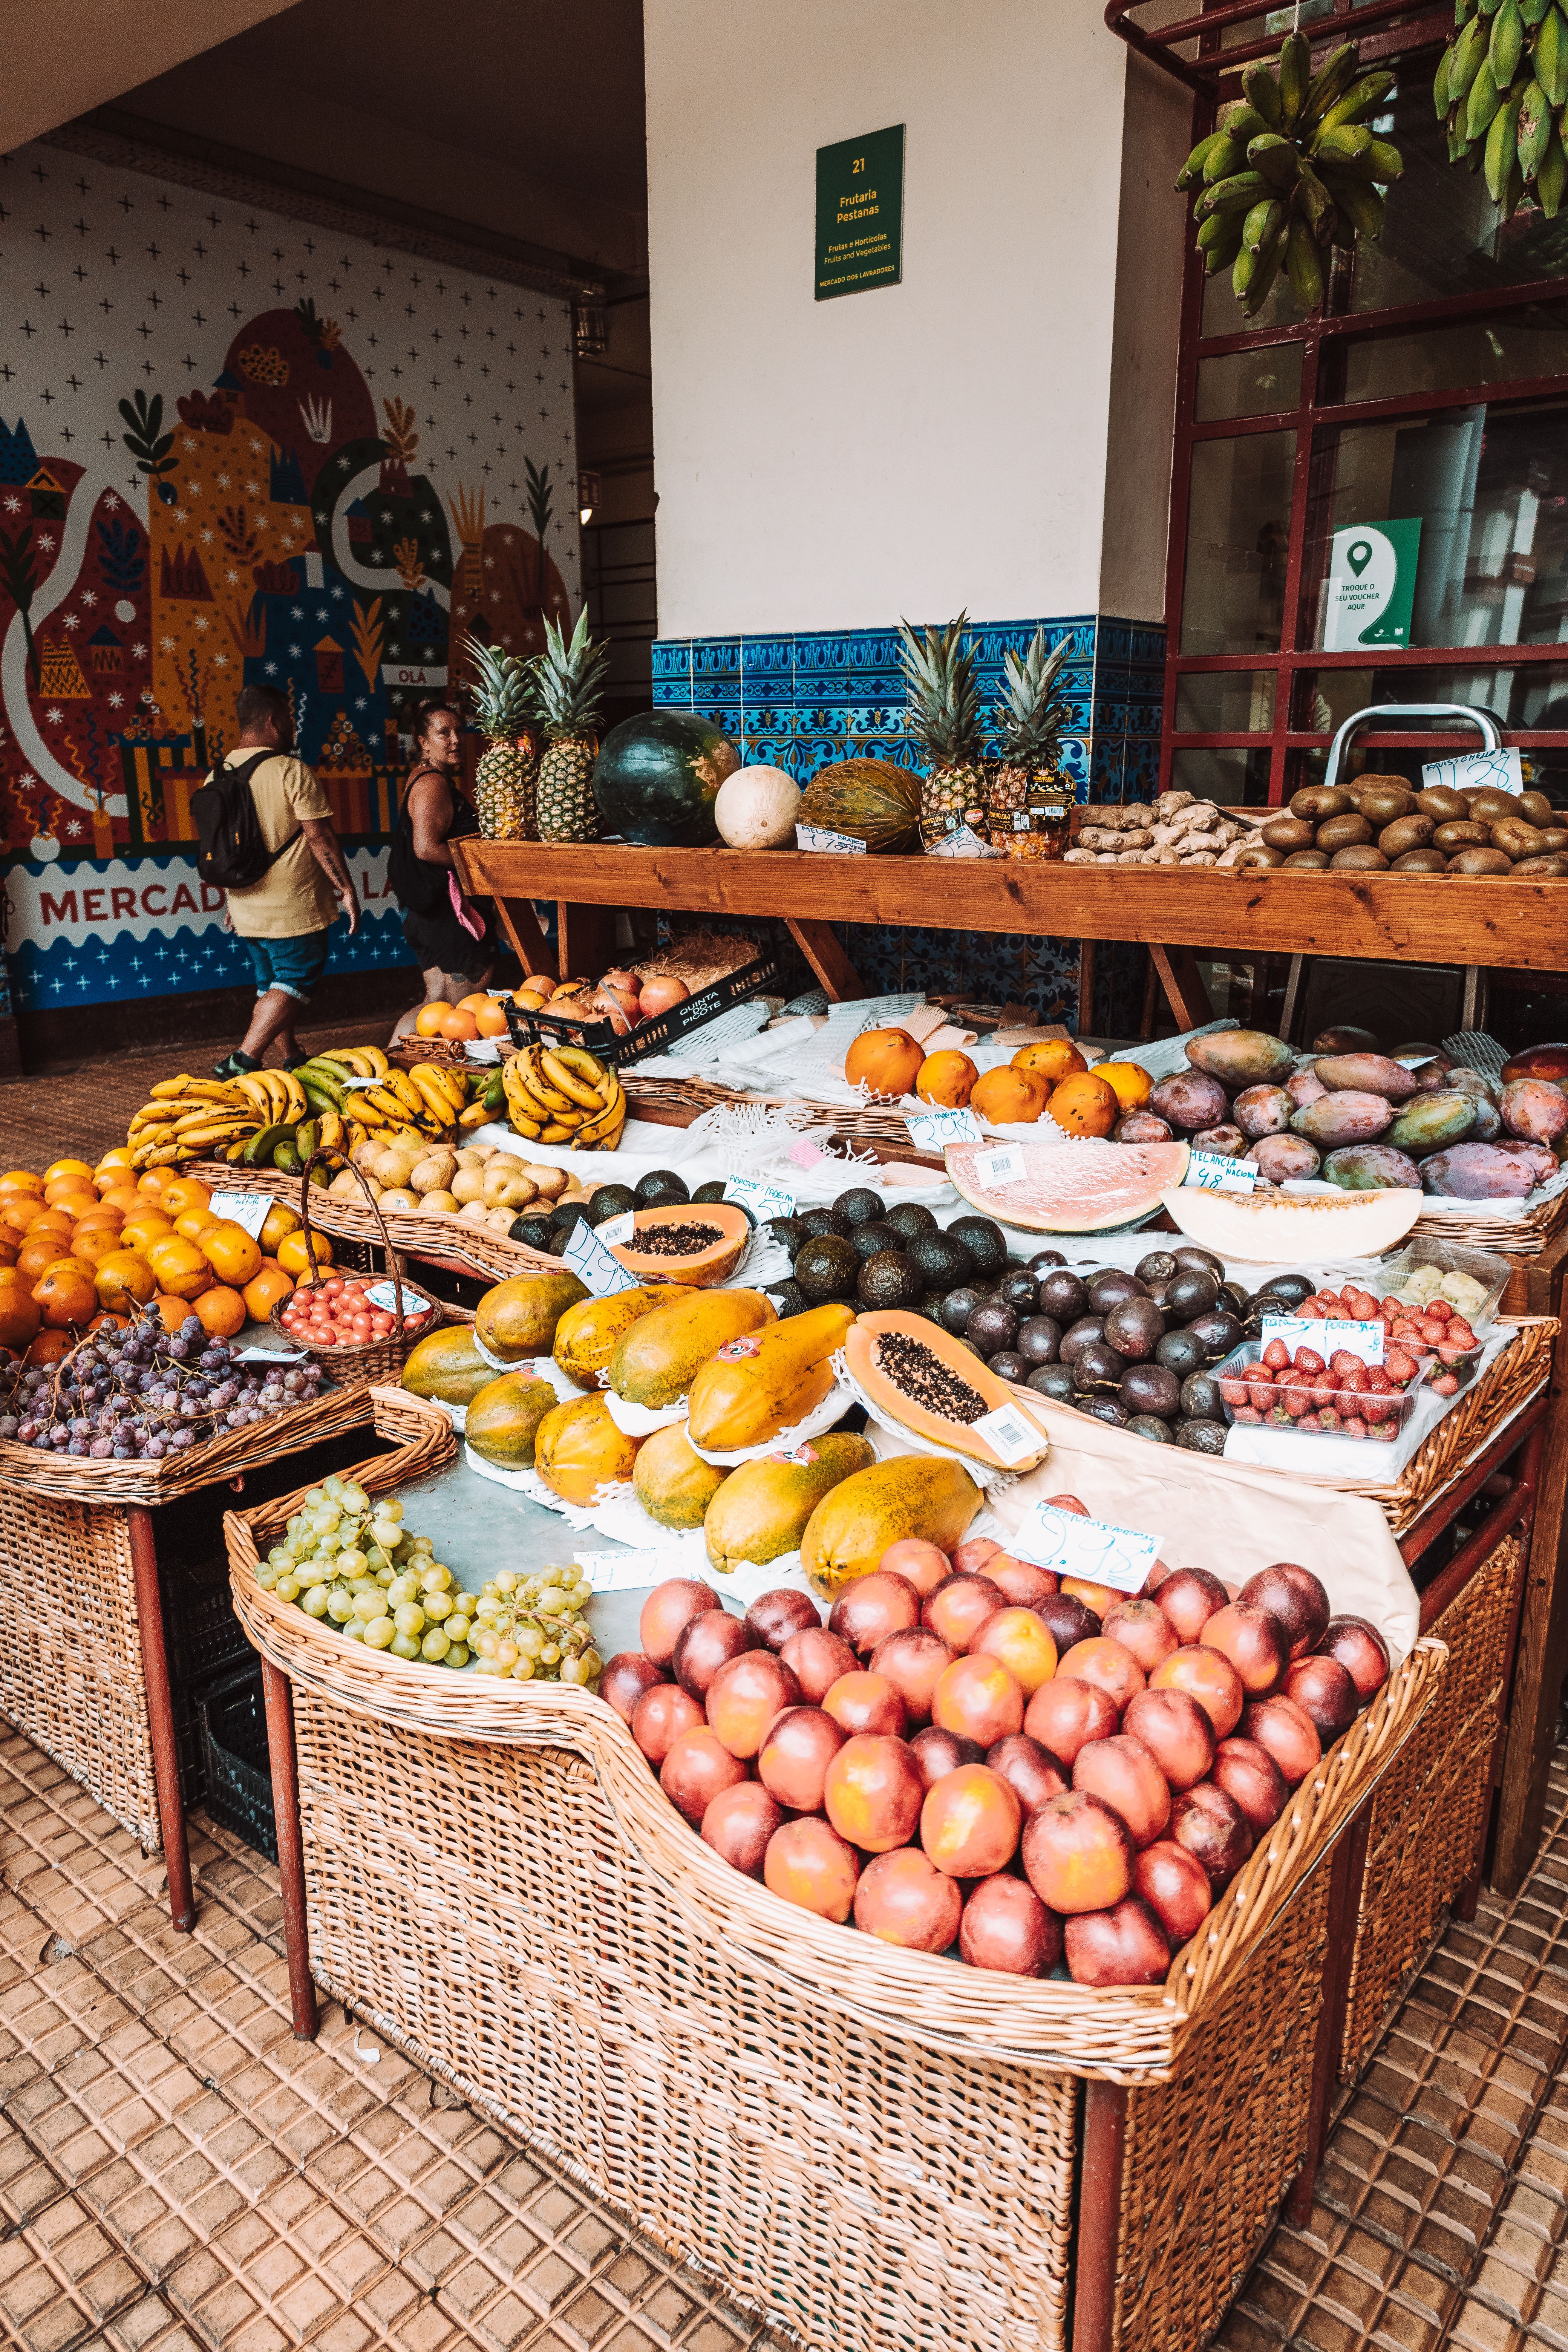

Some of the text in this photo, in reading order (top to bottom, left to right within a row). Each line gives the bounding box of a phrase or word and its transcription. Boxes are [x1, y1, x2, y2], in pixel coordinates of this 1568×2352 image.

[853, 158, 865, 173] 21
[840, 189, 877, 207] Frutaria
[837, 205, 879, 223] Pestanas
[824, 243, 891, 265] Fruits and Vegetables
[828, 242, 848, 253] Frutas
[819, 276, 845, 287] MERCADO
[859, 265, 894, 279] LAVRADORES
[398, 668, 427, 684] OLÁ
[40, 881, 226, 925] MERCAD
[680, 992, 719, 1015] QUINTA
[692, 1003, 707, 1014] DO
[682, 1000, 721, 1026] PICOTE
[1003, 1407, 1019, 1423] PESTANA
[1000, 1439, 1013, 1453] BRASIL
